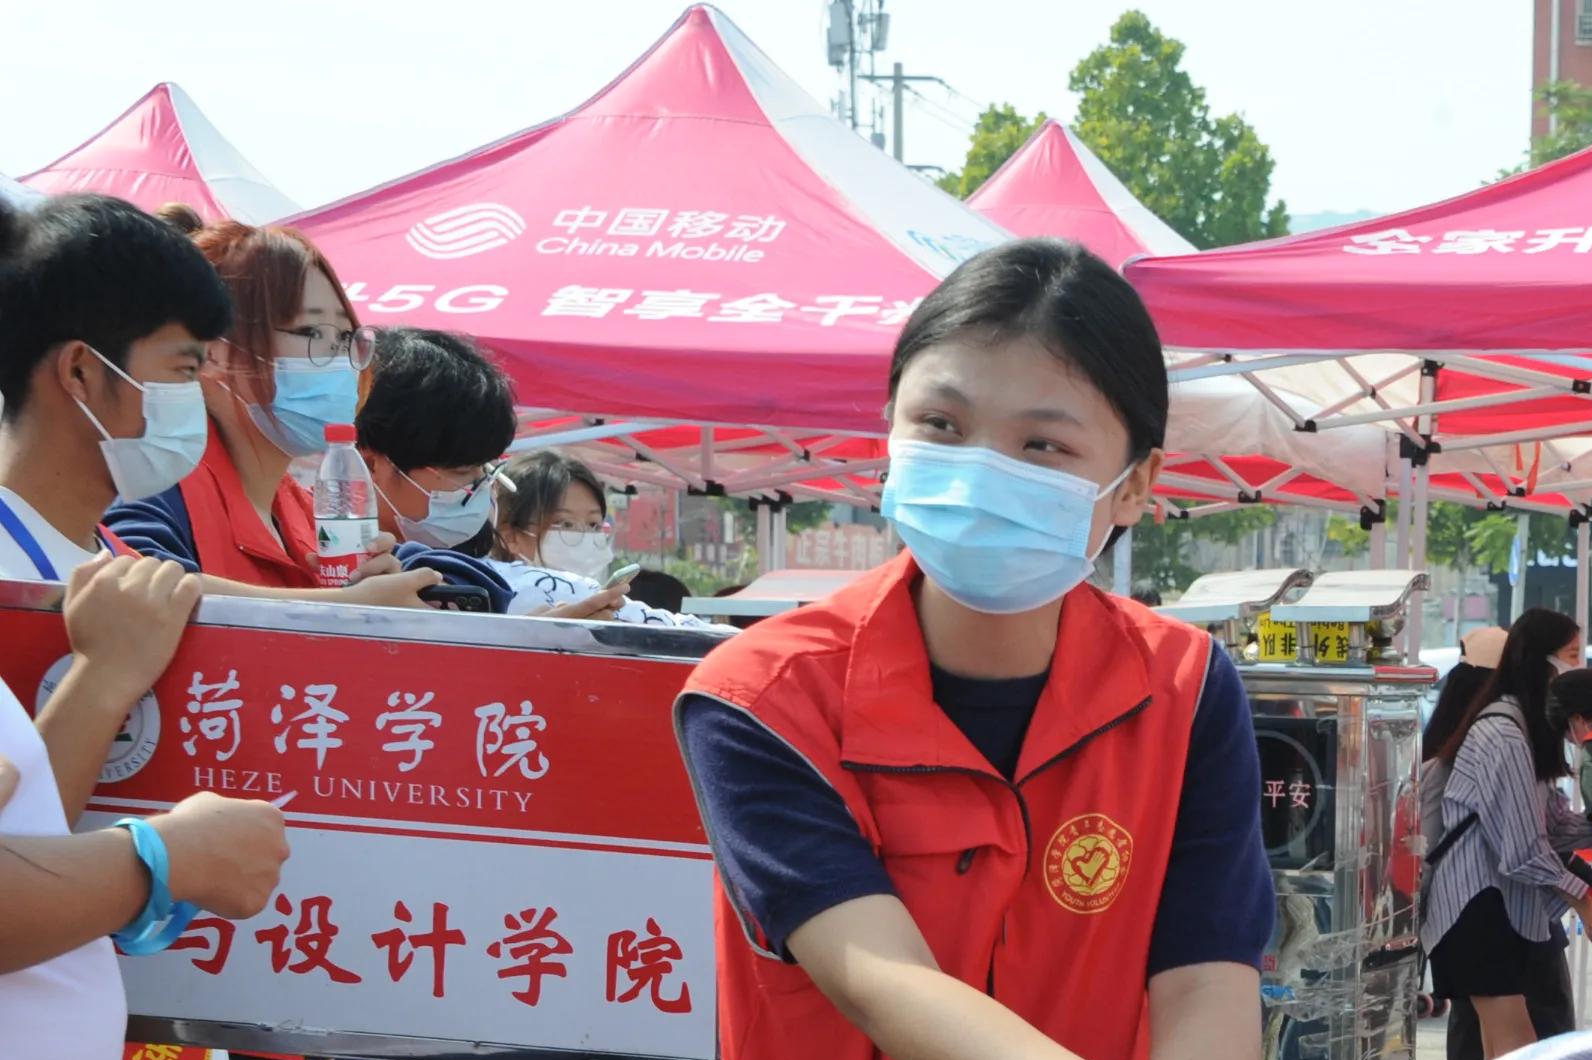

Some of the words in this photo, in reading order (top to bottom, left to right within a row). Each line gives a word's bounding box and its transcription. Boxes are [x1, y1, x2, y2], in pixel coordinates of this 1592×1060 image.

[550, 204, 787, 243] 中国移动
[535, 236, 636, 257] China
[644, 241, 767, 264] Mobile
[349, 281, 510, 313] 5G
[179, 669, 551, 781] 菏泽学院
[192, 766, 284, 794] HEZE
[312, 775, 535, 814] UNIVERSITY
[1263, 780, 1311, 809] 平安
